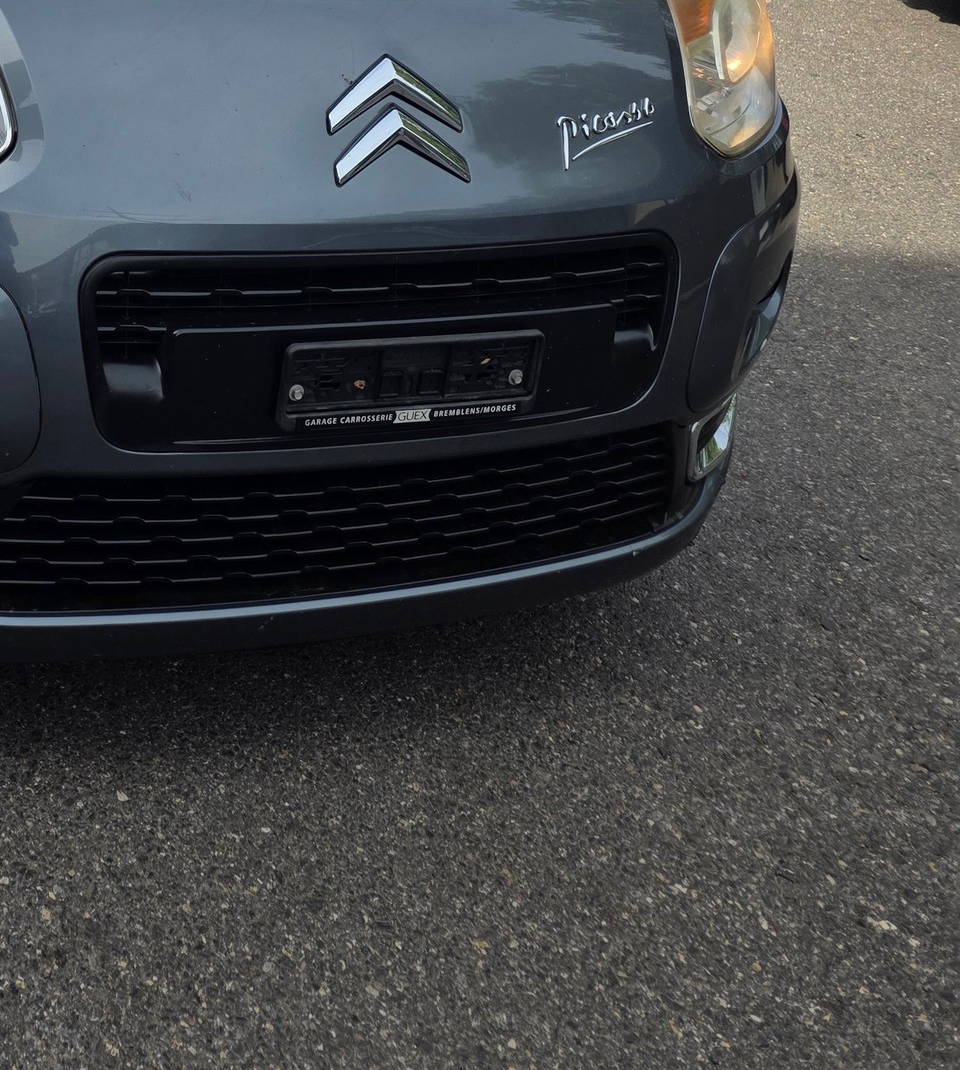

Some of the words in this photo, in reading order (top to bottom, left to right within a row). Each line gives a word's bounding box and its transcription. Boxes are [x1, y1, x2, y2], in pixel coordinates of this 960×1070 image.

[304, 417, 337, 426] GARAGE
[340, 413, 393, 424] CARROSSERIE
[397, 410, 428, 422] GUEX
[433, 404, 517, 417] BREMBLENS/MORGES
